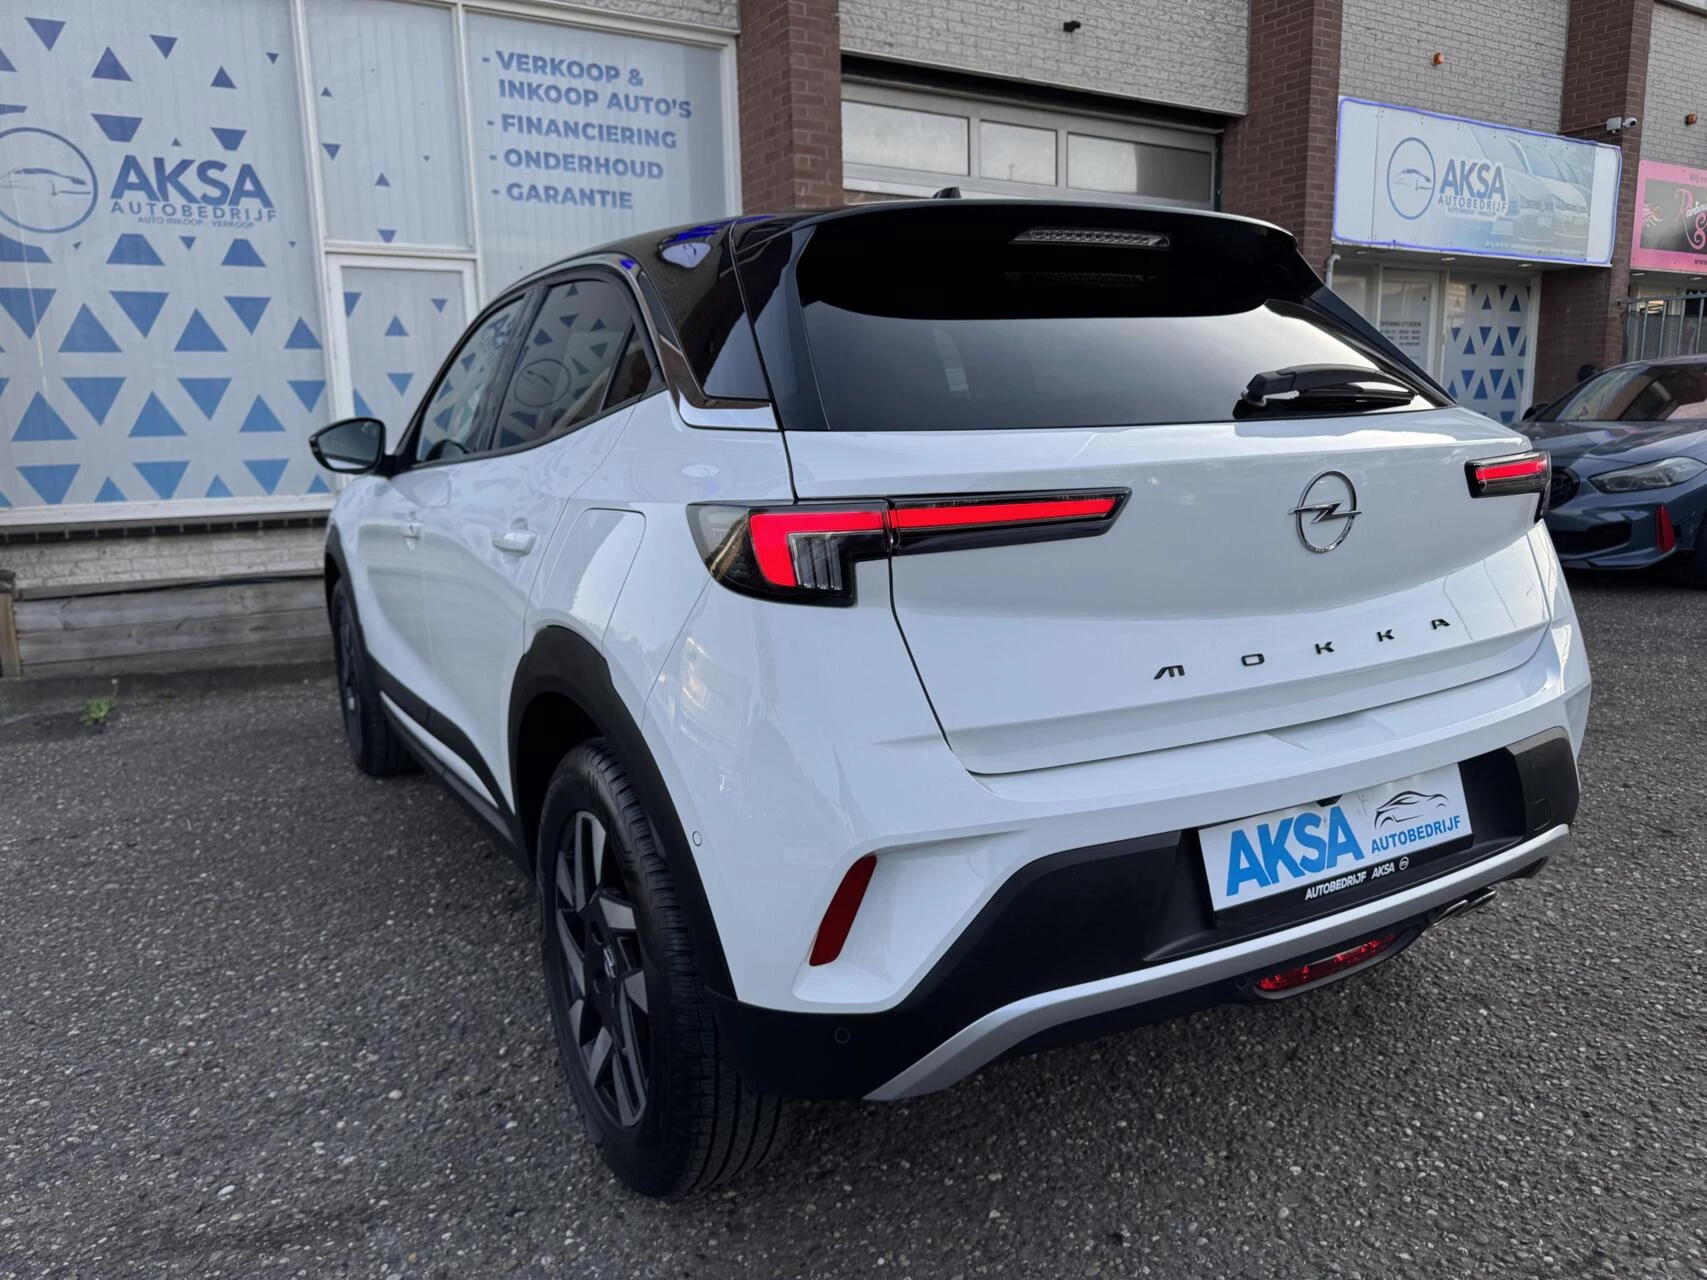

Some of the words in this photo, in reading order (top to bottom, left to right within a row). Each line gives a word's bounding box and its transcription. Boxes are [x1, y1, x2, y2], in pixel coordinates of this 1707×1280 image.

[495, 50, 620, 83] VERKOOP
[628, 68, 644, 87] &
[498, 79, 599, 107] INKOOP
[606, 92, 692, 119] AUTO'S
[501, 114, 677, 149] FINANCIERING
[110, 154, 275, 209] AKSA
[504, 149, 664, 180] ONDERHOUD
[1439, 158, 1506, 201] AKSA
[111, 201, 277, 222] AUTOBEDRIJF
[506, 182, 633, 209] GARANTIE
[1438, 195, 1507, 213] AUTOBEDRIJF
[138, 216, 164, 224] AUTO
[1226, 805, 1365, 896] AKSA
[1371, 815, 1461, 854] AUTOBEDRIJF
[1305, 871, 1367, 900] AUTOBEDRIJF
[1371, 862, 1395, 879] AKSA
